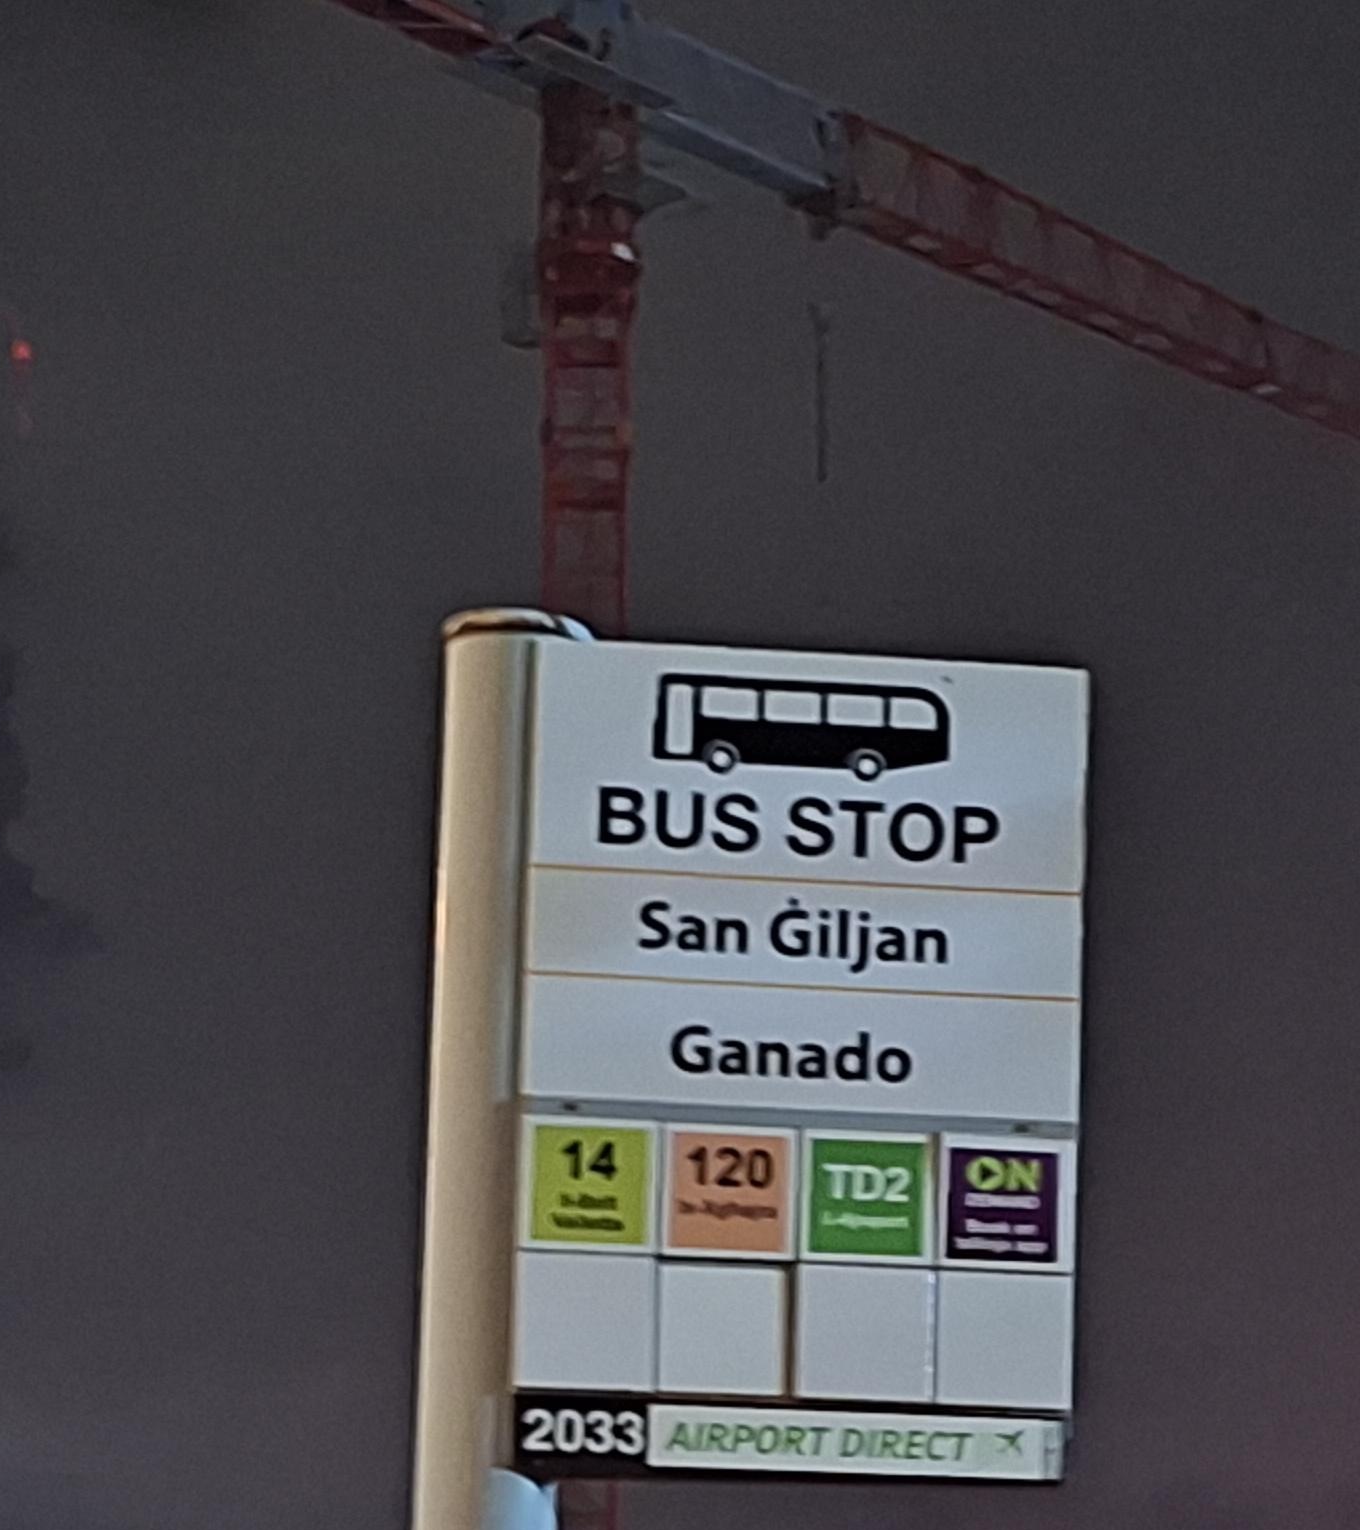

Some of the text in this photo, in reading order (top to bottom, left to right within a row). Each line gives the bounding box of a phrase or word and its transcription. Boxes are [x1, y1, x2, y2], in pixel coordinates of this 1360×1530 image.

[597, 785, 1001, 864] BUS STOP
[638, 897, 949, 974] San Ġiljan
[670, 1024, 912, 1083] Ganado
[561, 1139, 617, 1181] 14
[686, 1145, 775, 1189] 120
[820, 1162, 911, 1203] TD2
[521, 1407, 645, 1456] 2033
[665, 1421, 974, 1462] AIRPORT DIRECT
